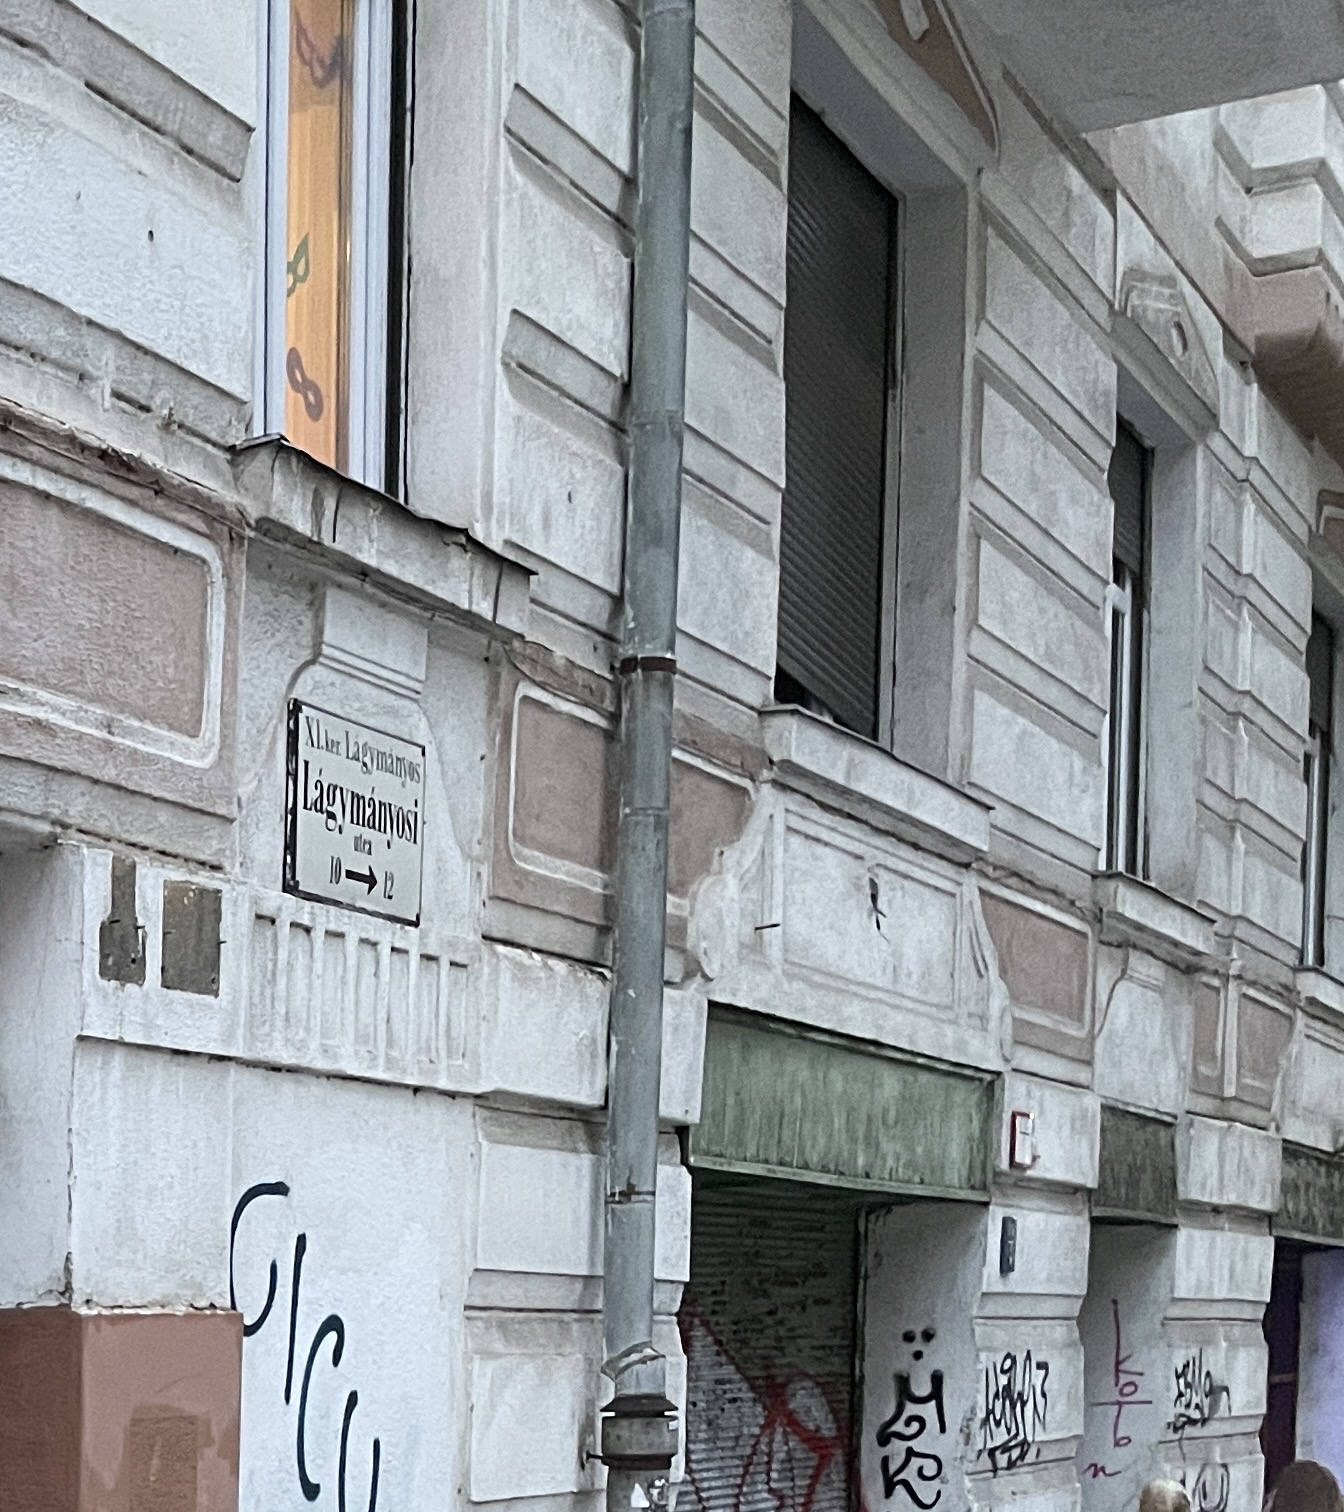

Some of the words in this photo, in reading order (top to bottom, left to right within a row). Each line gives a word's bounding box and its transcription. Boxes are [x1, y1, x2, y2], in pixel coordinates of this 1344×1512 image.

[344, 731, 421, 788] Lágymányos
[303, 760, 418, 849] Lágymányosi
[354, 834, 372, 855] utca
[330, 856, 342, 885] 10
[383, 871, 394, 899] 12
